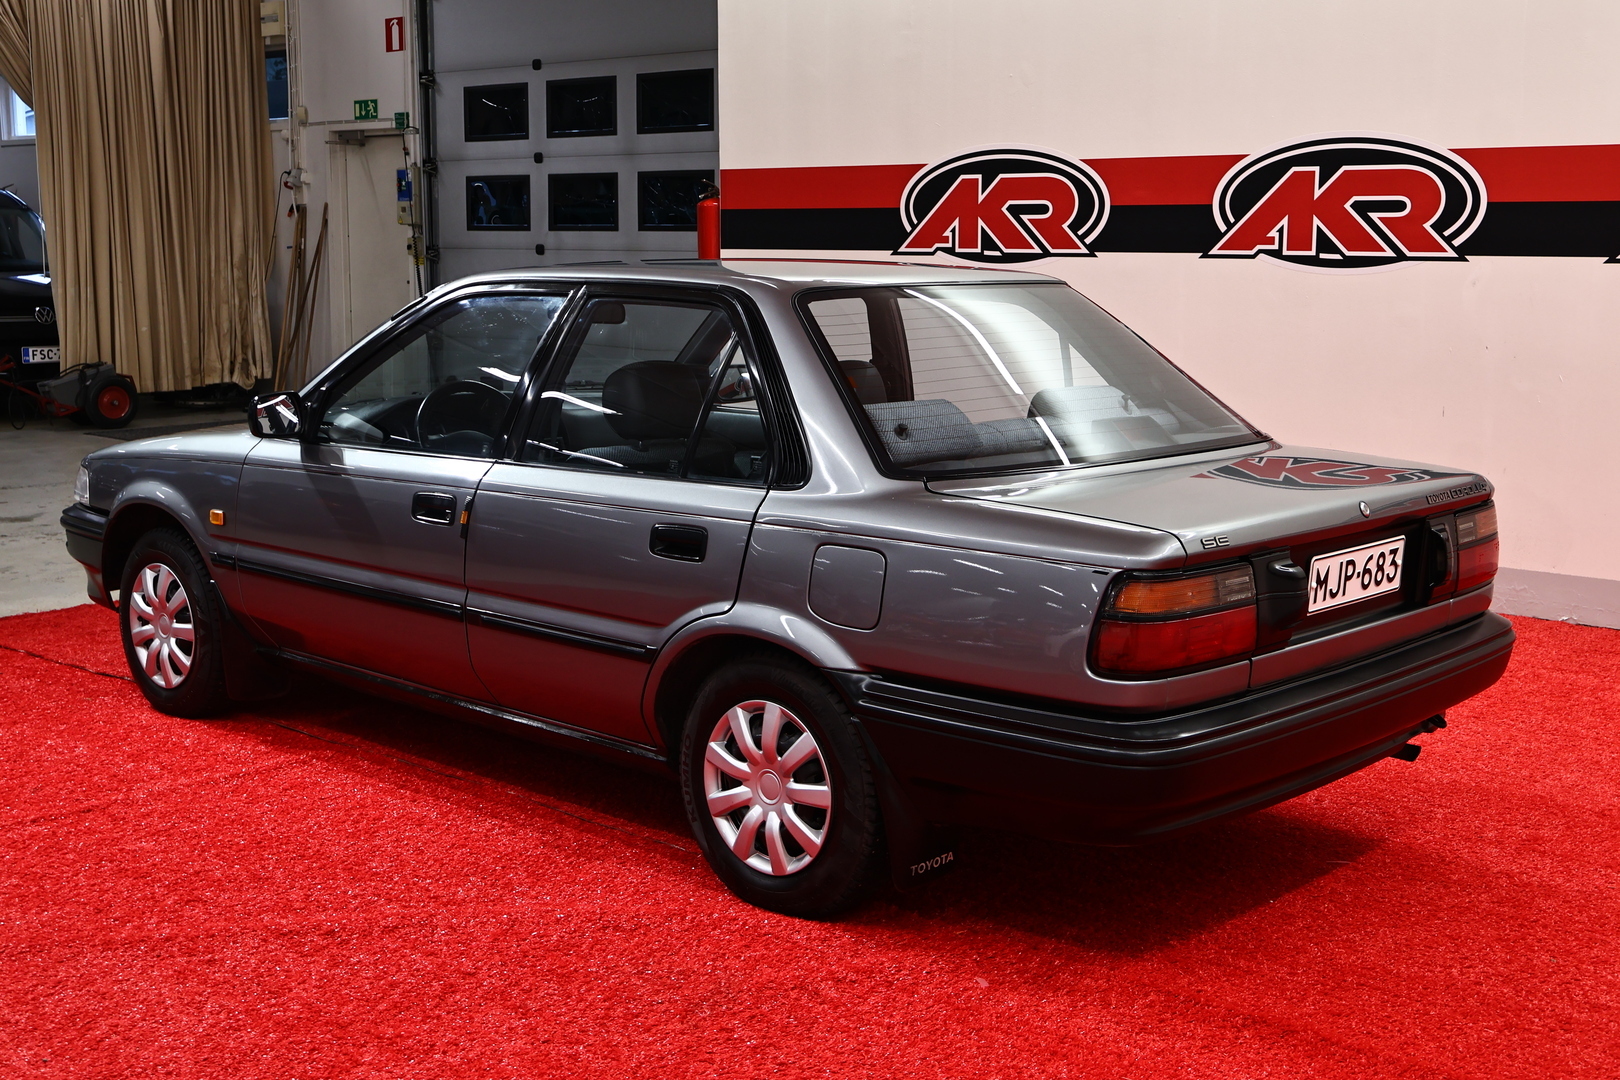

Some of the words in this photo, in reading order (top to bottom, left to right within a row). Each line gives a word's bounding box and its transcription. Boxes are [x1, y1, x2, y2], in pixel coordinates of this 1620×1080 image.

[897, 173, 1090, 253] AKR
[1207, 164, 1459, 257] AKR
[1426, 490, 1451, 504] TOYOTA
[1450, 483, 1487, 499] COROLLA
[1201, 535, 1230, 549] SE
[1313, 546, 1400, 604] MJP-683
[684, 733, 698, 823] KUMHO
[910, 851, 954, 876] TOYOTA
